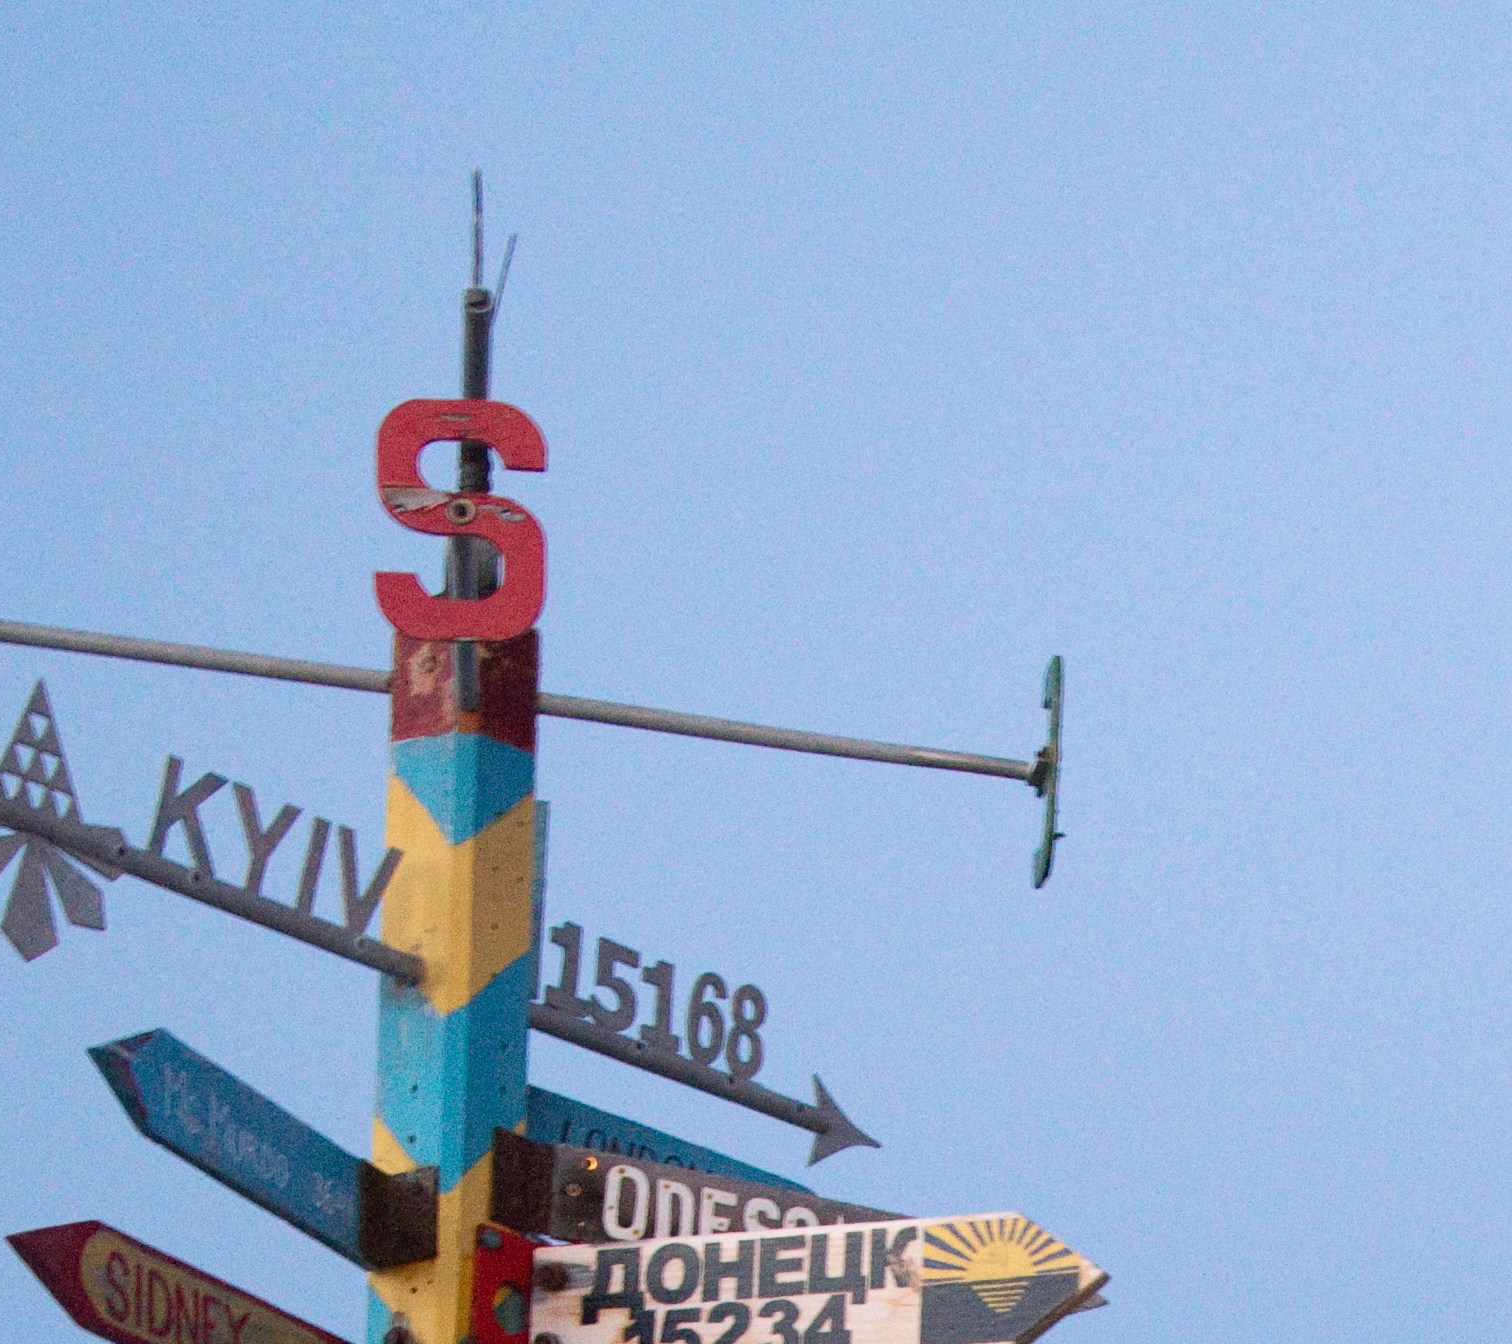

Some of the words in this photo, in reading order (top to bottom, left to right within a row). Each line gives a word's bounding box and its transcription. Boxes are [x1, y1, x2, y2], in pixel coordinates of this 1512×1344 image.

[375, 398, 548, 641] S
[146, 755, 405, 934] KYIV
[543, 922, 768, 1082] 15168
[580, 1225, 919, 1325] ДОНЕЦК
